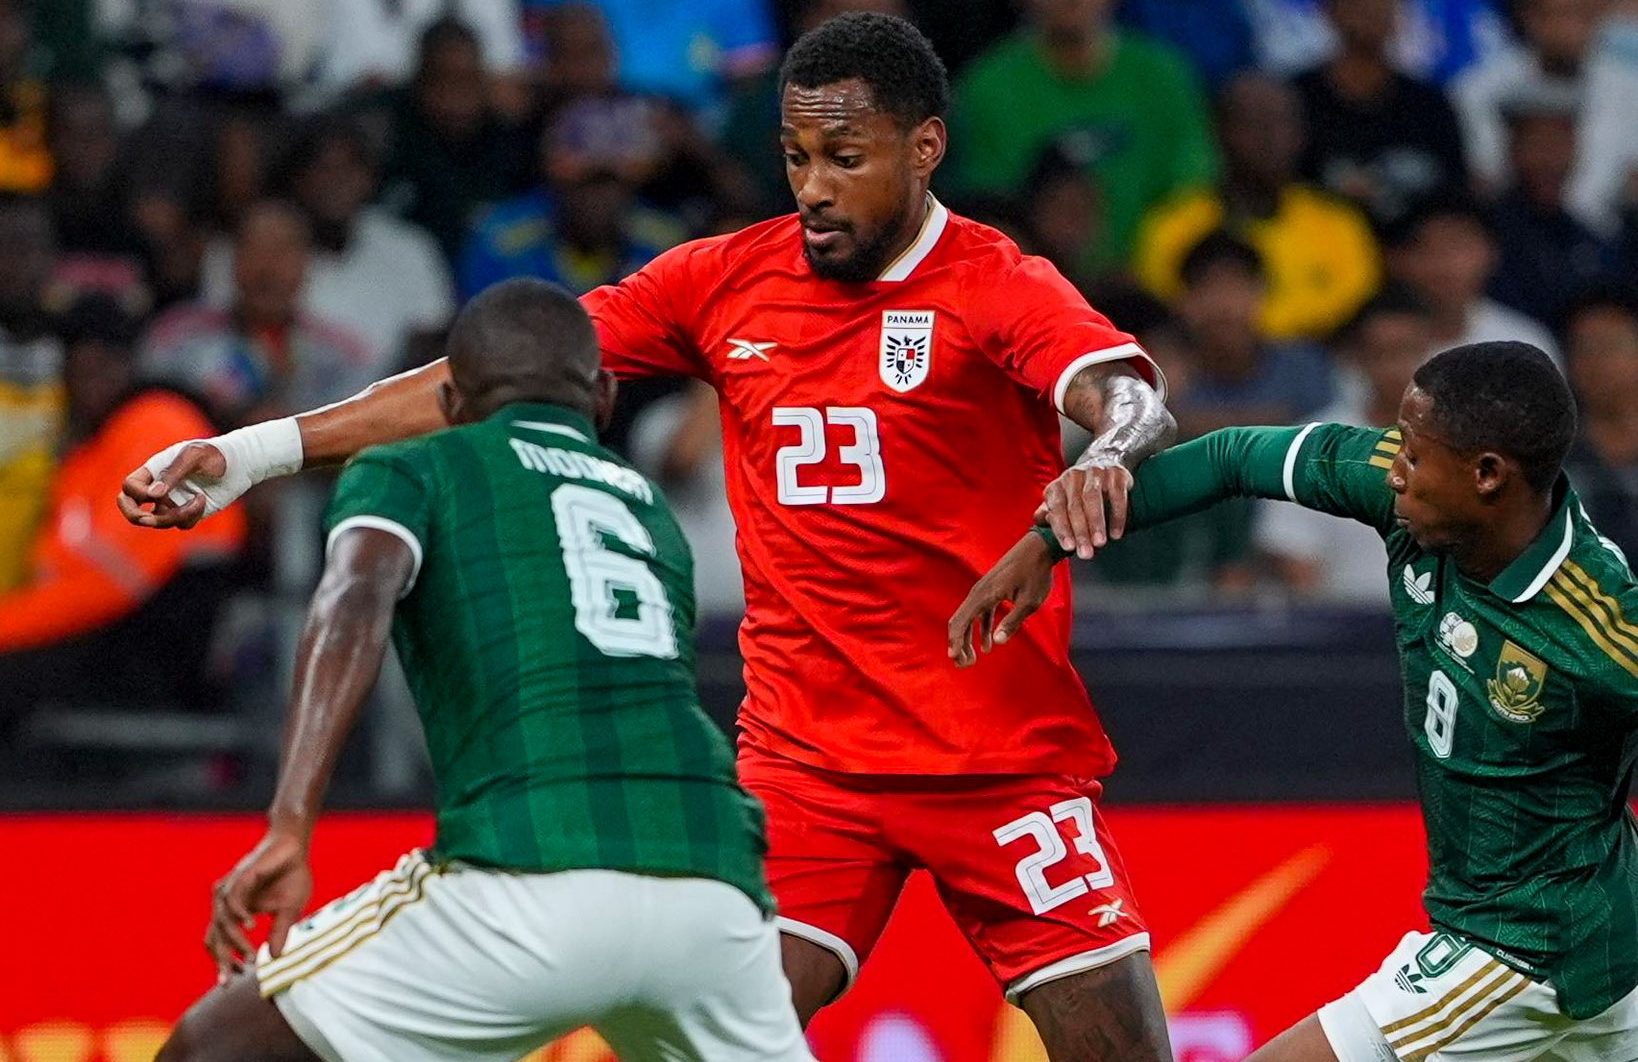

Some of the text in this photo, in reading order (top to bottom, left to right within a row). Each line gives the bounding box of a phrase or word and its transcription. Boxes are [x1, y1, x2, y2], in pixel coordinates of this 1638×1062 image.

[772, 406, 886, 506] 23
[551, 482, 680, 660] 6
[1424, 669, 1460, 759] 8
[992, 796, 1115, 916] 23
